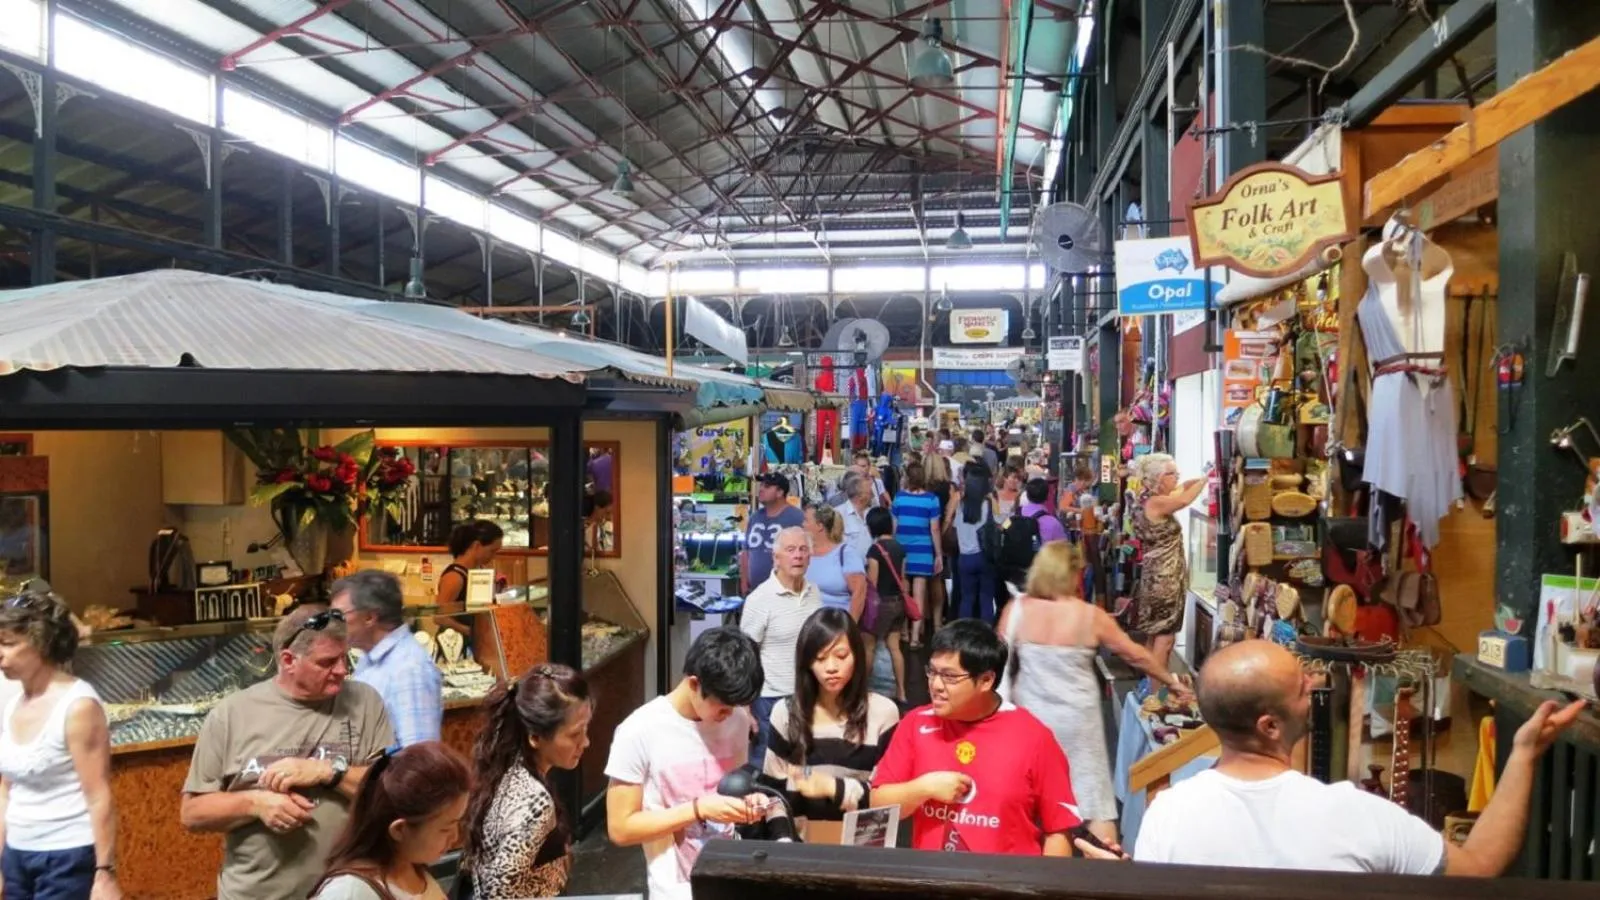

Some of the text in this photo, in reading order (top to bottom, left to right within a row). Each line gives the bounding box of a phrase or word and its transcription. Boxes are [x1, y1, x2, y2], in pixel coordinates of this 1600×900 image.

[1240, 178, 1290, 198] Orna's
[1220, 197, 1318, 231] Folk Art
[1247, 221, 1294, 239] & Craft
[1148, 282, 1193, 302] Opal
[695, 426, 744, 437] Gardens
[748, 523, 782, 549] 63
[921, 803, 1000, 829] odafone
